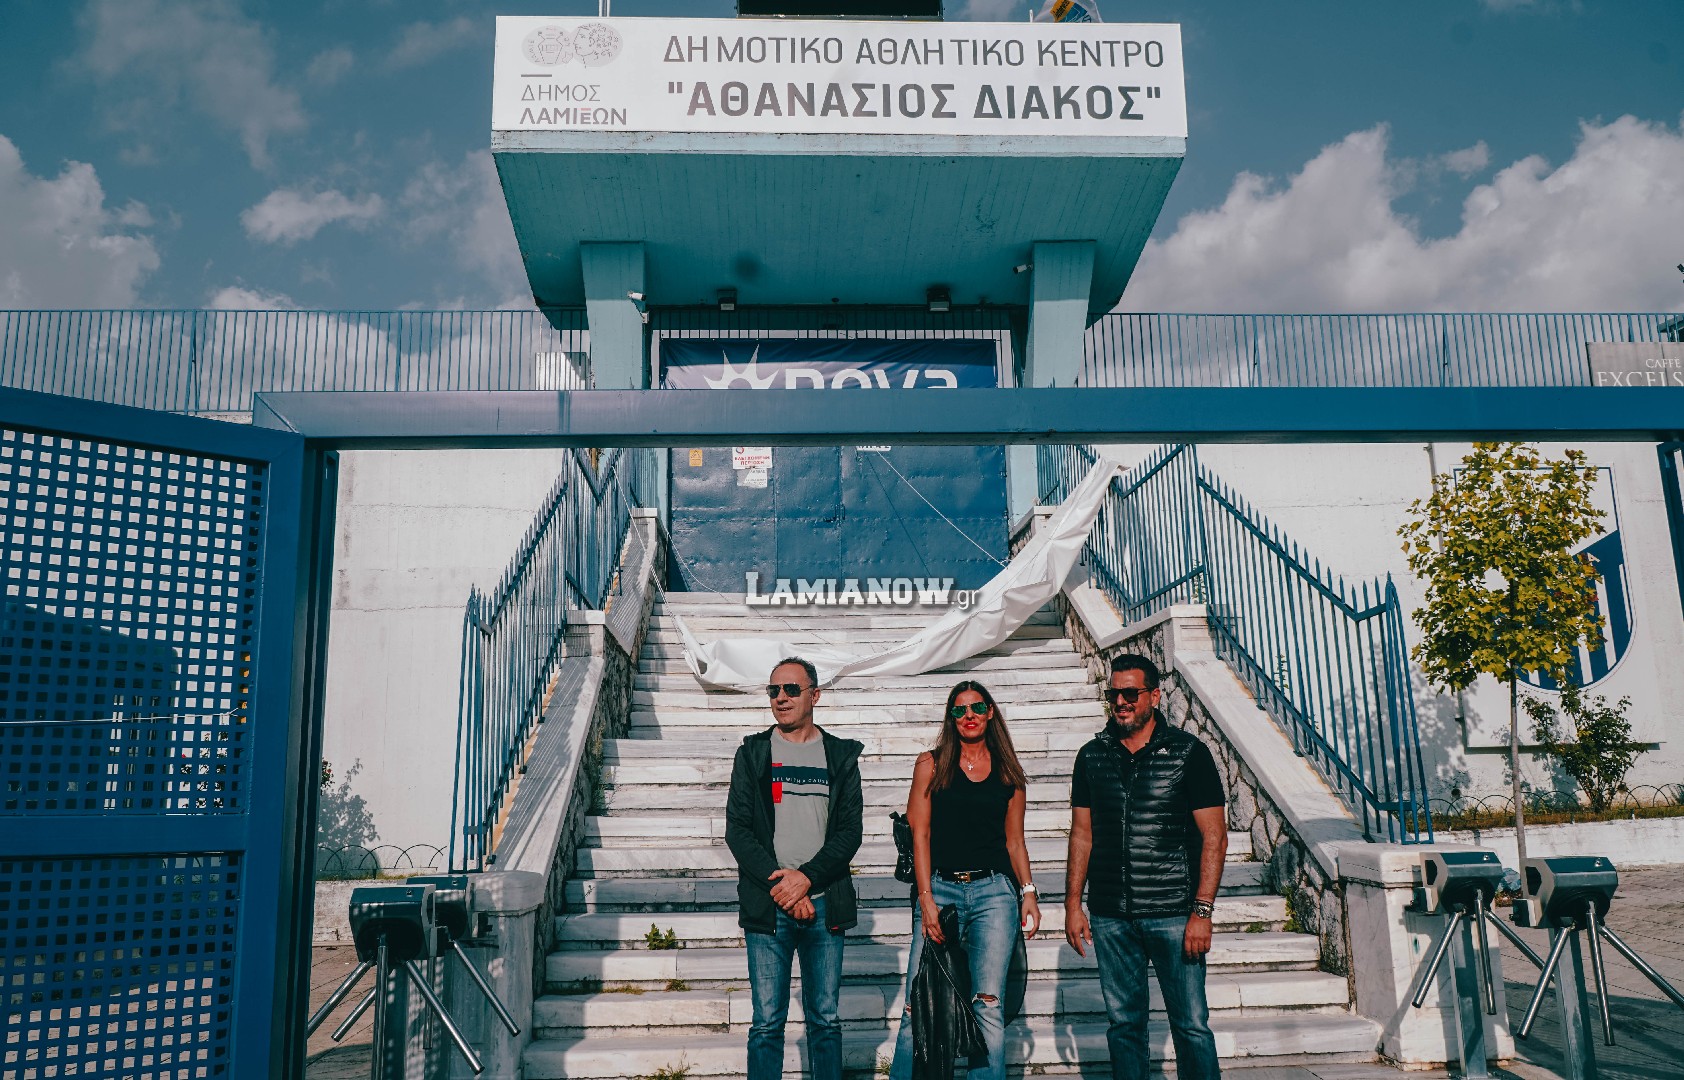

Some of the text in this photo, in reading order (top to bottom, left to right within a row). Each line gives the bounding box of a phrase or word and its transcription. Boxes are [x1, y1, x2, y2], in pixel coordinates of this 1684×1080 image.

[855, 38, 1025, 67] ΑΘΛΗΤΙΚΟ
[1037, 40, 1164, 68] ΚΕΝΤΡΟ
[521, 84, 601, 102] ΔΗΜΟΣ
[668, 81, 1161, 121] "ΑΘΑΝΑΣΙΟΣ ΔΙΑΚΟΣ"
[519, 107, 627, 125] ΛΑΜΙΕΩΝ
